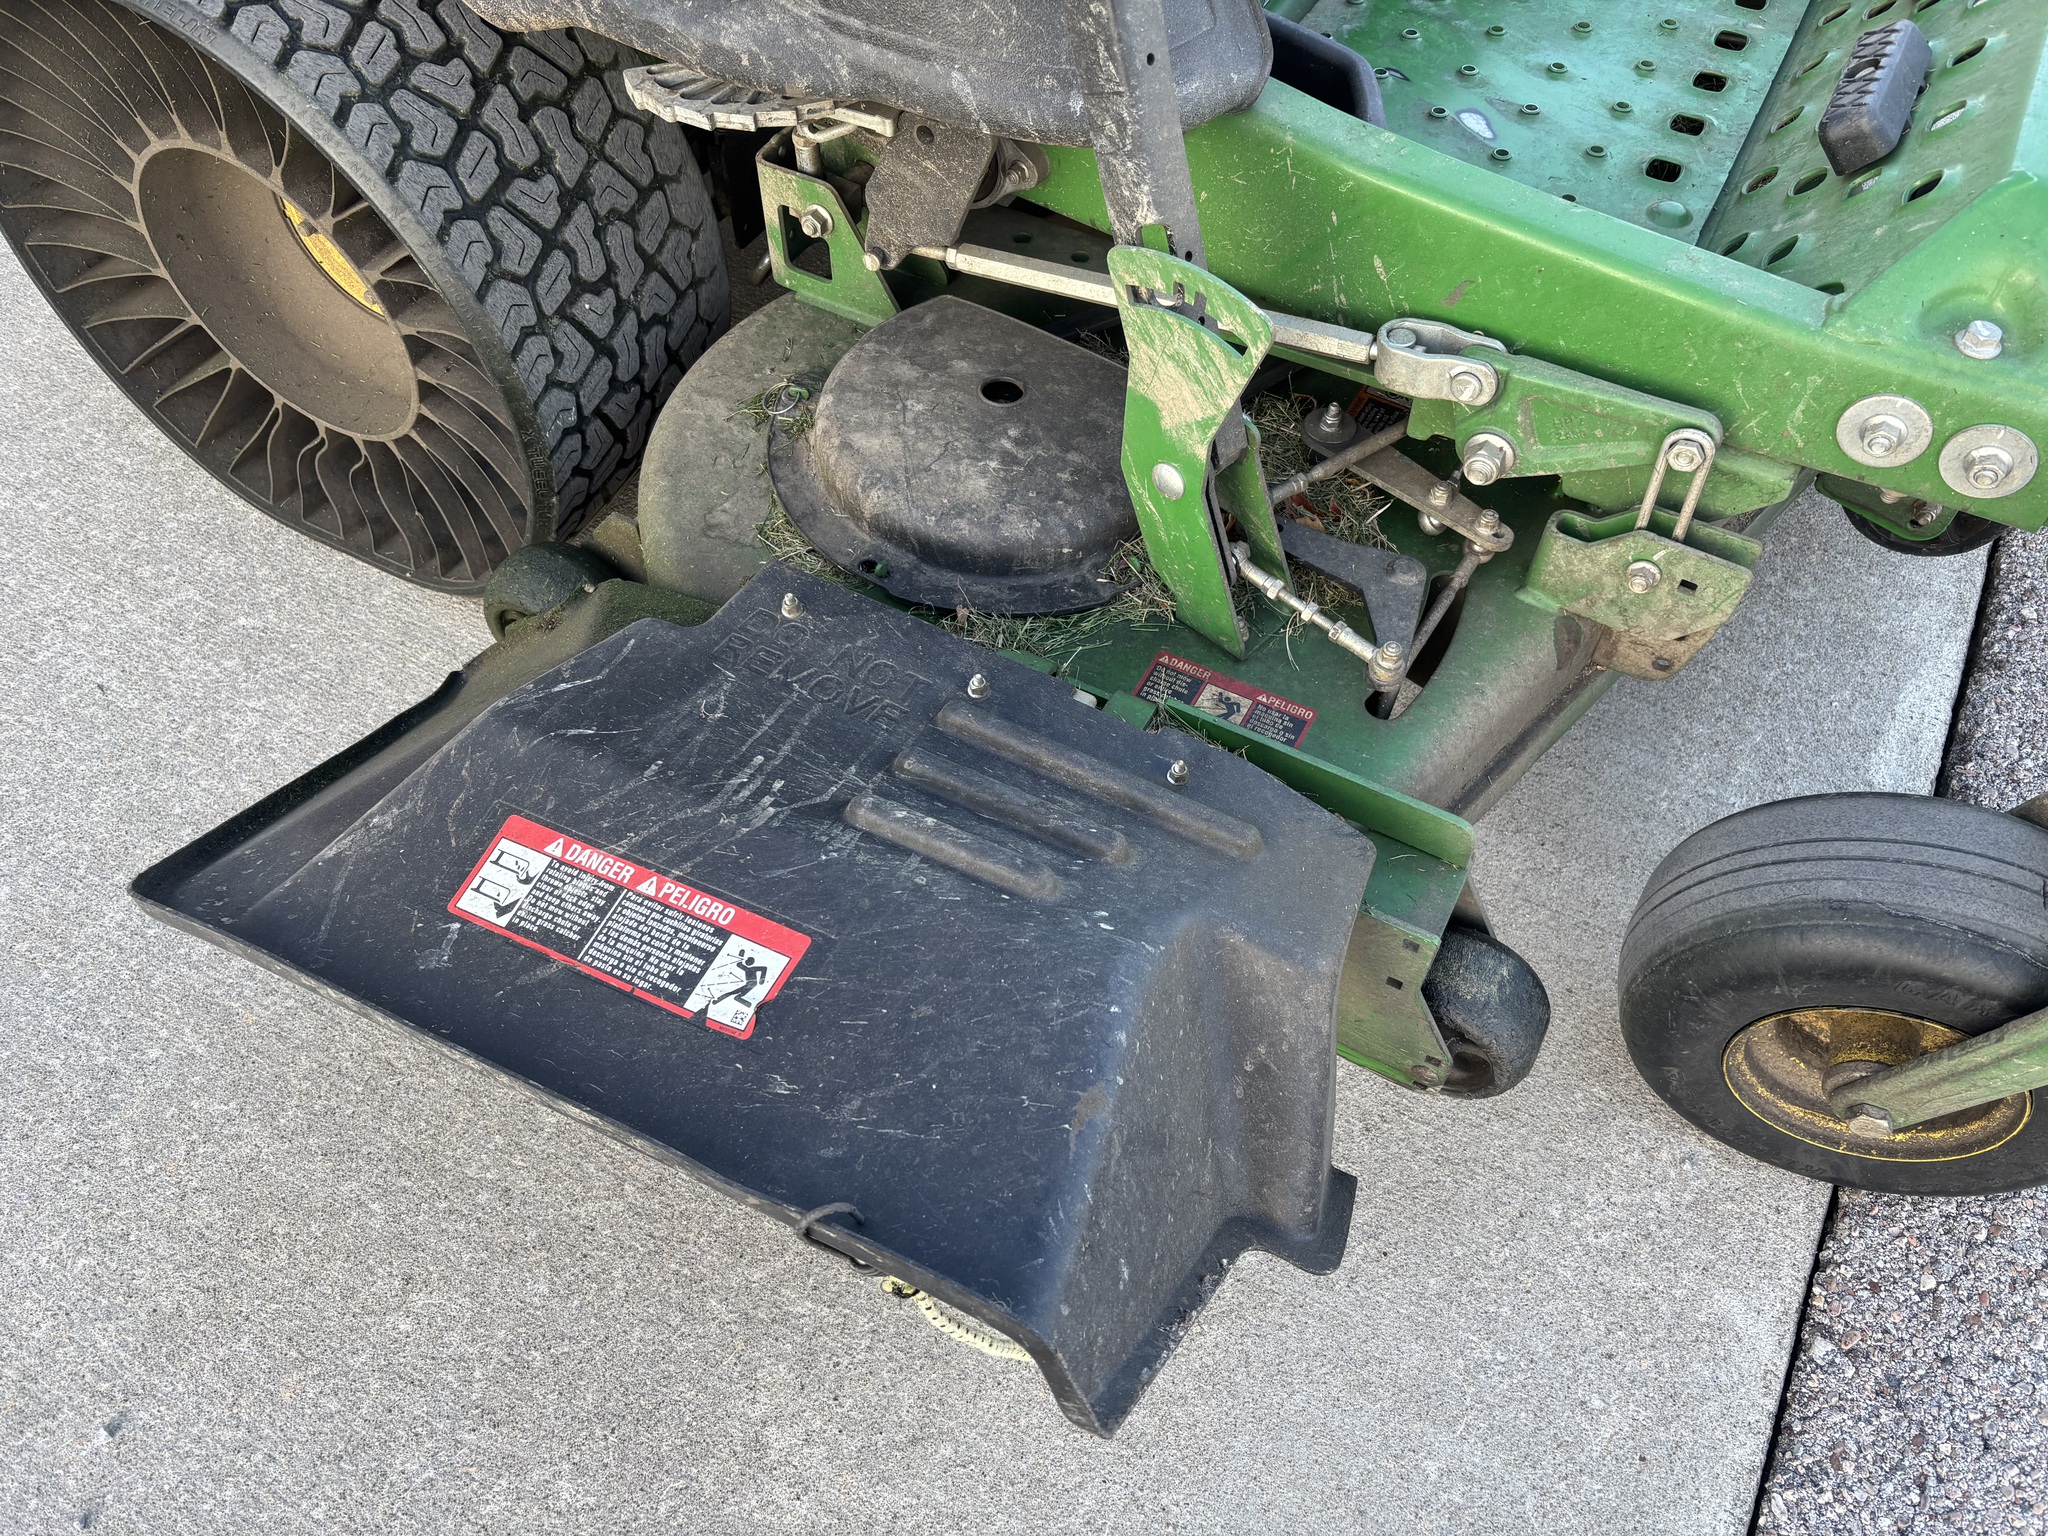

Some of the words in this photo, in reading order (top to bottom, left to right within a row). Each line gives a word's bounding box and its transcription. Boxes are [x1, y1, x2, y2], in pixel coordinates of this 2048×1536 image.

[527, 447, 549, 496] TWEEL
[736, 607, 812, 648] DO
[825, 643, 934, 699] NOT
[1169, 657, 1211, 680] DANGER
[711, 632, 911, 730] REMOVE
[1267, 696, 1313, 719] PELIGRO
[559, 865, 579, 876] avoid
[598, 879, 615, 892] from
[564, 843, 635, 884] DANGER
[535, 881, 554, 892] clear
[561, 891, 578, 903] deck
[577, 899, 595, 910] edge
[540, 873, 564, 888] thrown
[590, 895, 606, 907] stay
[544, 867, 572, 883] rotating
[570, 877, 596, 892] blades
[594, 887, 609, 898] and
[521, 900, 553, 920] discharge
[553, 916, 573, 928] chute
[530, 888, 545, 898] and
[542, 893, 560, 905] keep
[560, 901, 582, 914] others
[536, 899, 549, 909] not
[547, 905, 564, 915] mow
[564, 912, 590, 926] without
[625, 891, 643, 903] Para
[643, 899, 664, 912] evitar
[663, 908, 685, 920] sufrir
[684, 915, 715, 933] lesiones
[657, 881, 735, 925] PELIGRO
[516, 909, 536, 922] entire
[535, 918, 555, 930] grass
[555, 926, 581, 941] catcher
[611, 912, 638, 928] alejado
[638, 923, 651, 933] del
[650, 928, 671, 942] borde
[619, 908, 646, 922] objetos
[676, 931, 716, 952] mantenerse
[621, 899, 651, 915] causadas
[648, 911, 663, 920] por
[662, 916, 692, 933] cuchillas
[690, 928, 724, 946] giratorias
[592, 941, 622, 958] máquina
[622, 953, 634, 963] sin
[642, 962, 659, 974] tubo
[605, 920, 642, 941] plataforma
[650, 939, 669, 950] corte
[673, 948, 706, 966] mantener
[607, 928, 619, 938] las
[619, 933, 642, 948] demás
[639, 944, 672, 961] personas
[671, 957, 701, 974] alejadas
[587, 947, 619, 966] descarga
[624, 964, 637, 974] sin
[645, 973, 682, 995] recogedor
[591, 959, 612, 972] pasto
[659, 961, 676, 972] usar
